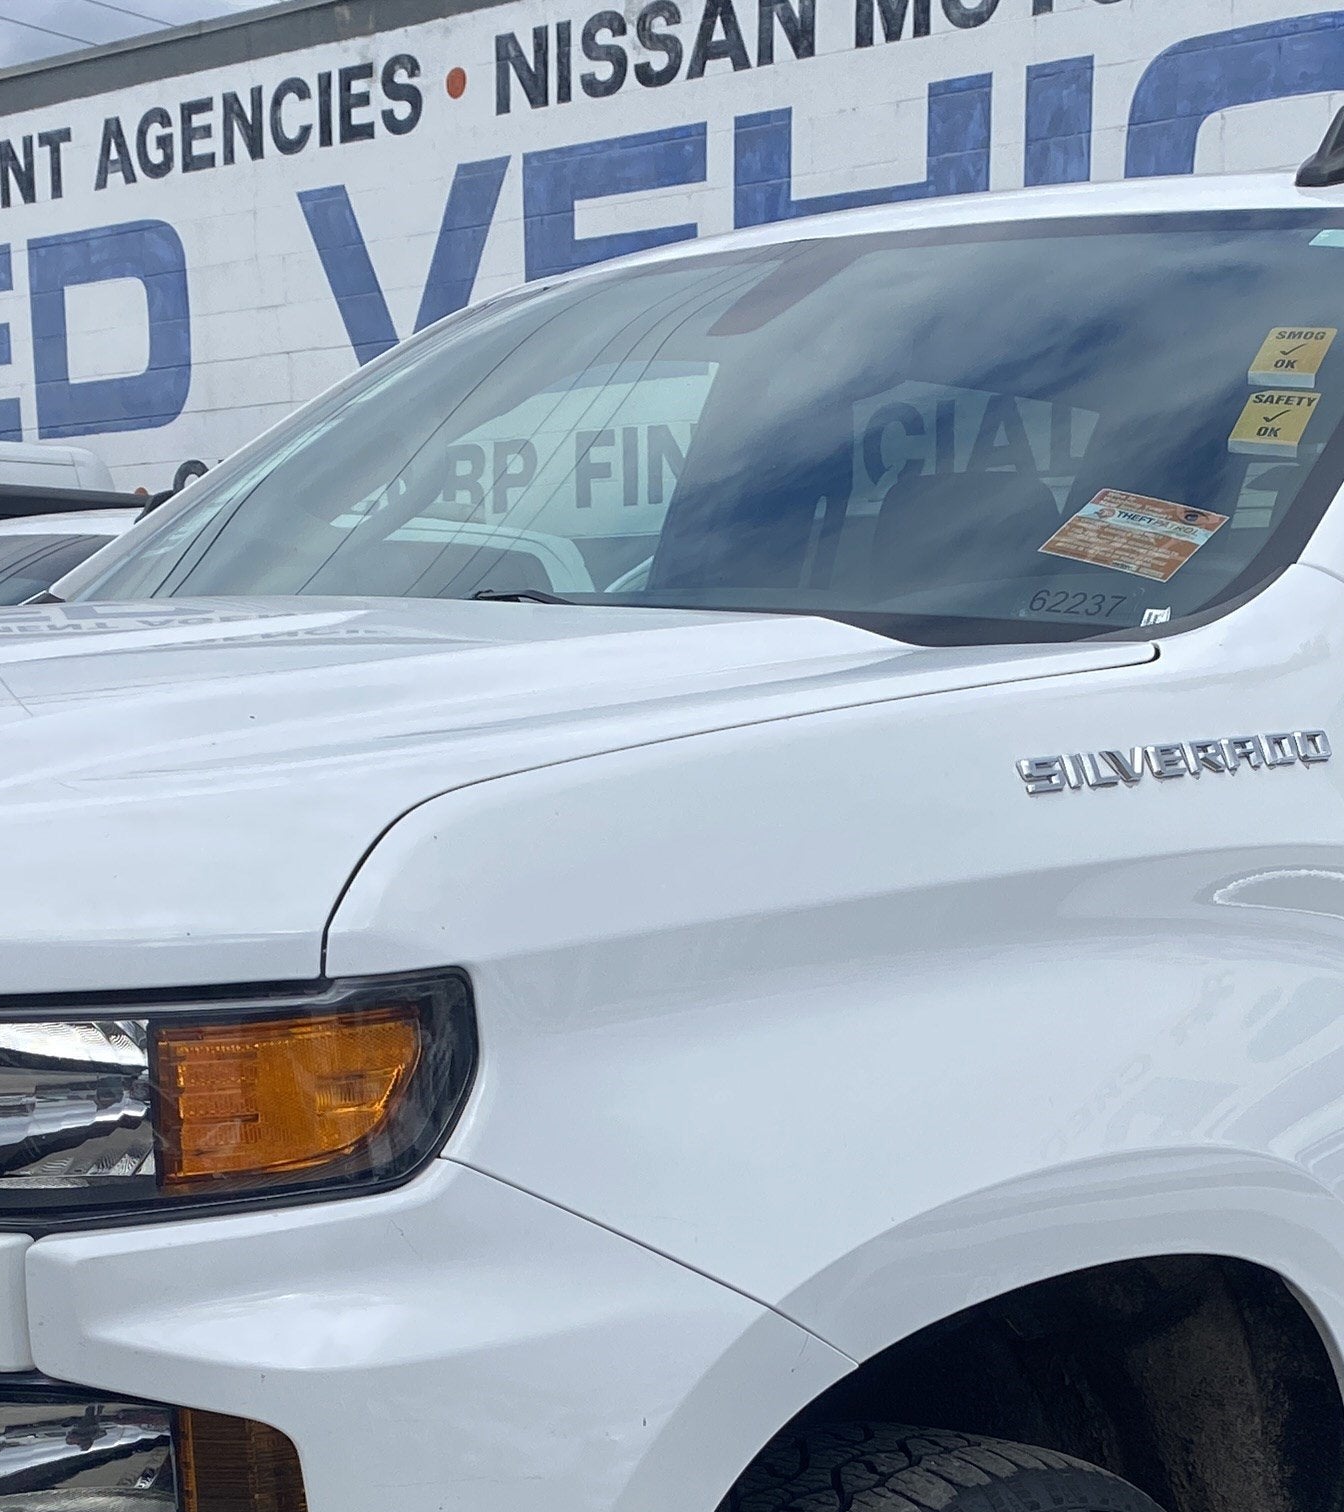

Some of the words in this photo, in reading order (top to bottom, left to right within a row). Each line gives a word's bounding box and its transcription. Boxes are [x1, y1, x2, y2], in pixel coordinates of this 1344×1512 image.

[93, 52, 423, 191] AGENCIES
[494, 0, 817, 116] NISSAN
[1275, 331, 1327, 340] SMOG
[1273, 359, 1298, 369] OK
[1253, 394, 1317, 407] SAFETY
[1256, 426, 1281, 437] OK
[1029, 588, 1127, 618] 62237
[1017, 728, 1333, 794] SILVERADO
